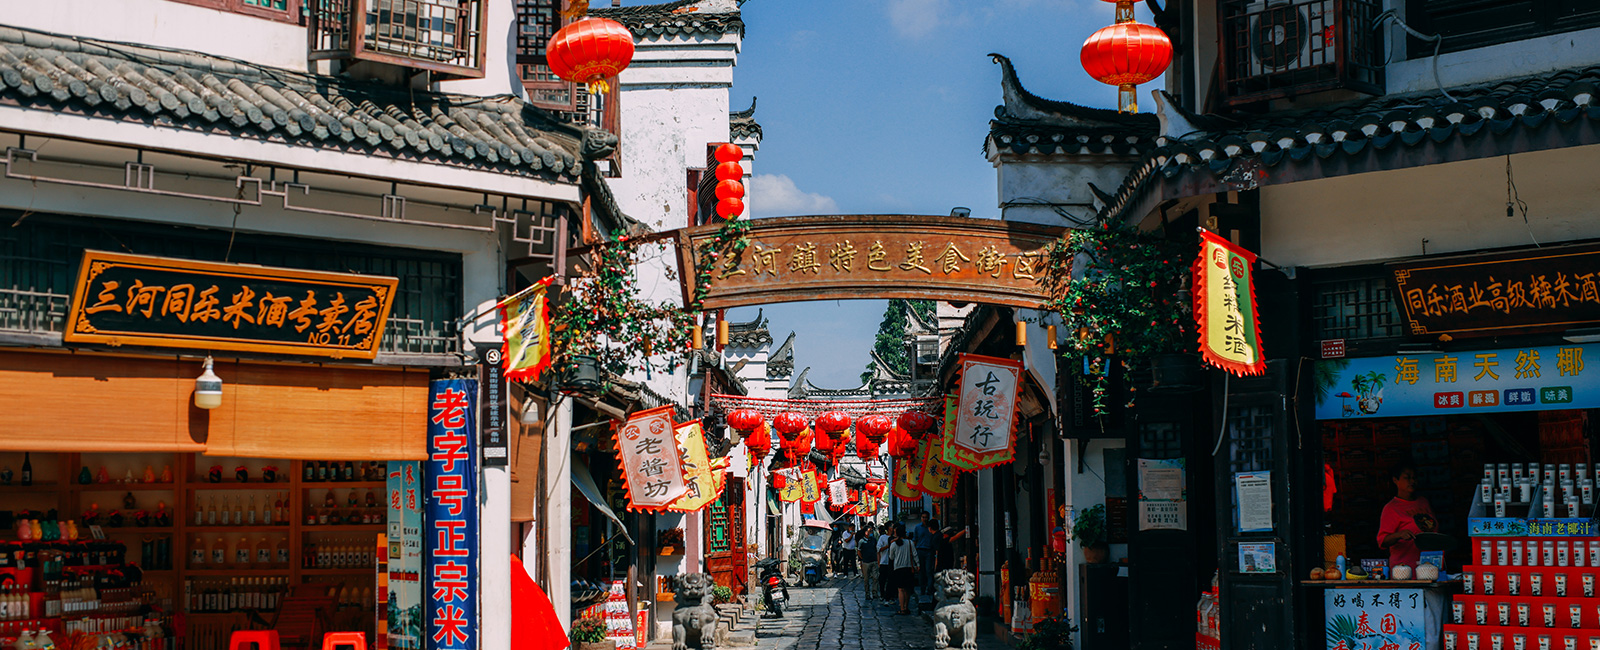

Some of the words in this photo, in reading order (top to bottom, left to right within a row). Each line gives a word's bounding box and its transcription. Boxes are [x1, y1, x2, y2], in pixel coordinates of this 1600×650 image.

[717, 240, 1038, 281] 三河鎮特色美食街区
[86, 279, 378, 336] 三河同乐米酒专卖店
[1406, 271, 1600, 317] 同乐酒业高级糯米酒
[1394, 347, 1585, 385] 海南天然椰
[970, 371, 1000, 447] 古玩行
[1437, 394, 1460, 406] 冰爽
[1472, 392, 1496, 404] 解渴
[1508, 390, 1533, 403] 鲜嫩
[1544, 389, 1568, 401] 味美
[636, 437, 671, 498] 老酱坊
[405, 464, 416, 510] 米酒
[432, 388, 469, 650] 老字号正宗米
[1529, 522, 1591, 535] 海南老椰汁
[1333, 592, 1419, 609] 好喝不得了
[1355, 610, 1397, 636] 泰国
